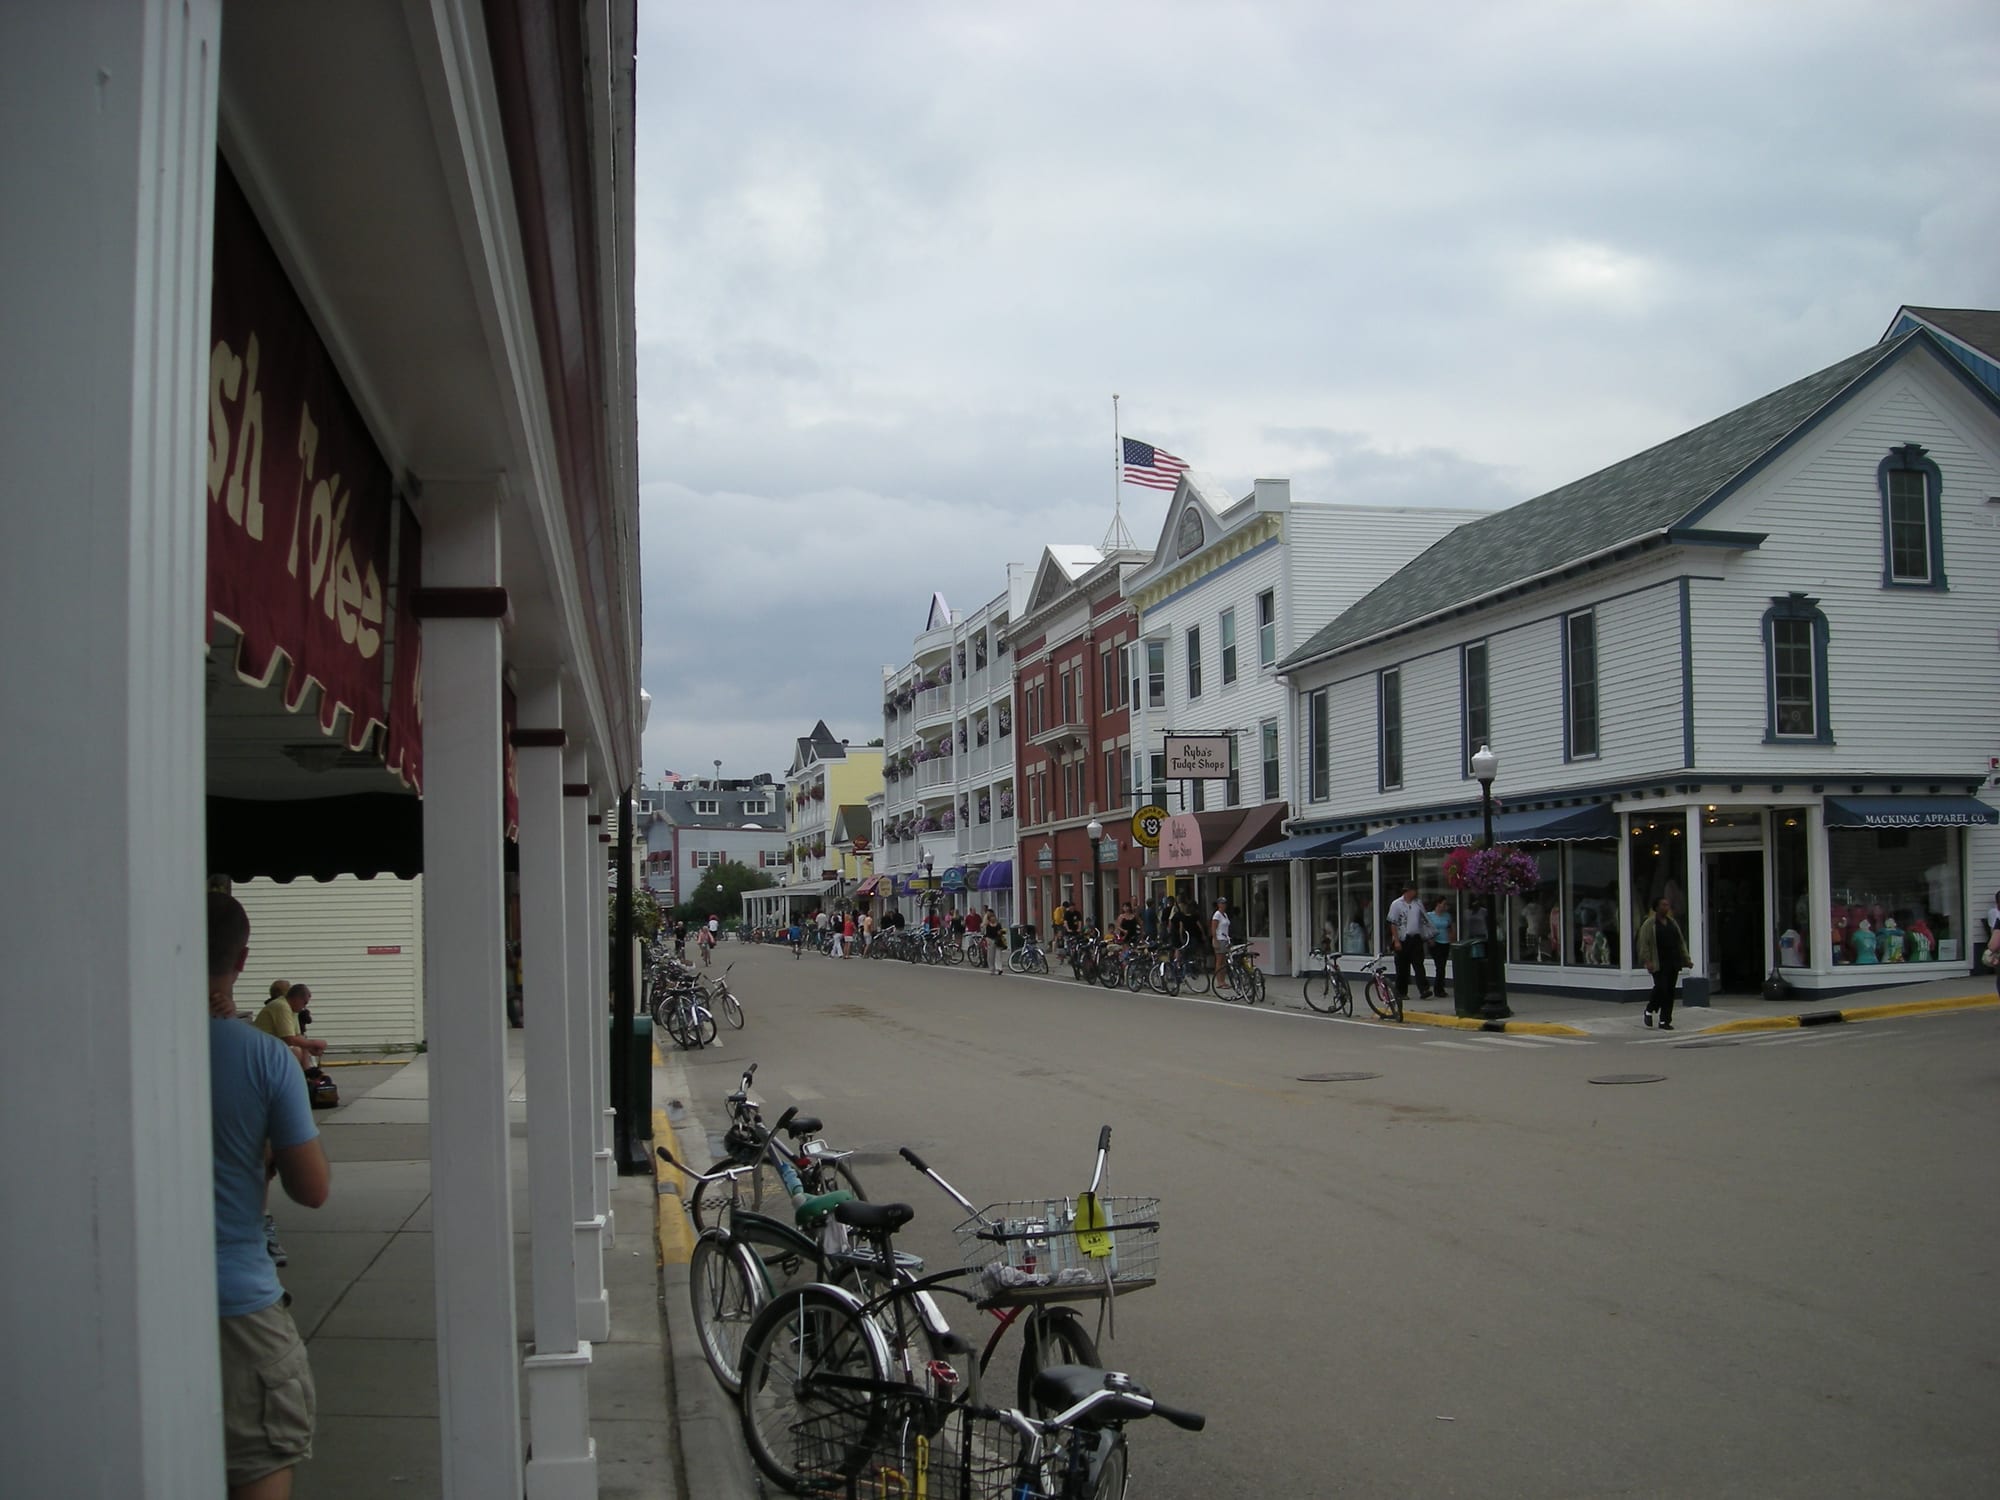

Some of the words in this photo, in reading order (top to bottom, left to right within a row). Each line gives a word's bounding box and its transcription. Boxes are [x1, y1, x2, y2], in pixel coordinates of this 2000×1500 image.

[1183, 744, 1212, 759] Ryba's
[1171, 758, 1196, 772] Fudge
[1198, 758, 1225, 772] Shops
[1865, 814, 1921, 824] MACKINAC
[1924, 814, 1969, 823] APPAREL
[1970, 814, 1988, 823] CO.
[1384, 840, 1423, 850] MACKINAC
[1425, 834, 1458, 847] APPAREL
